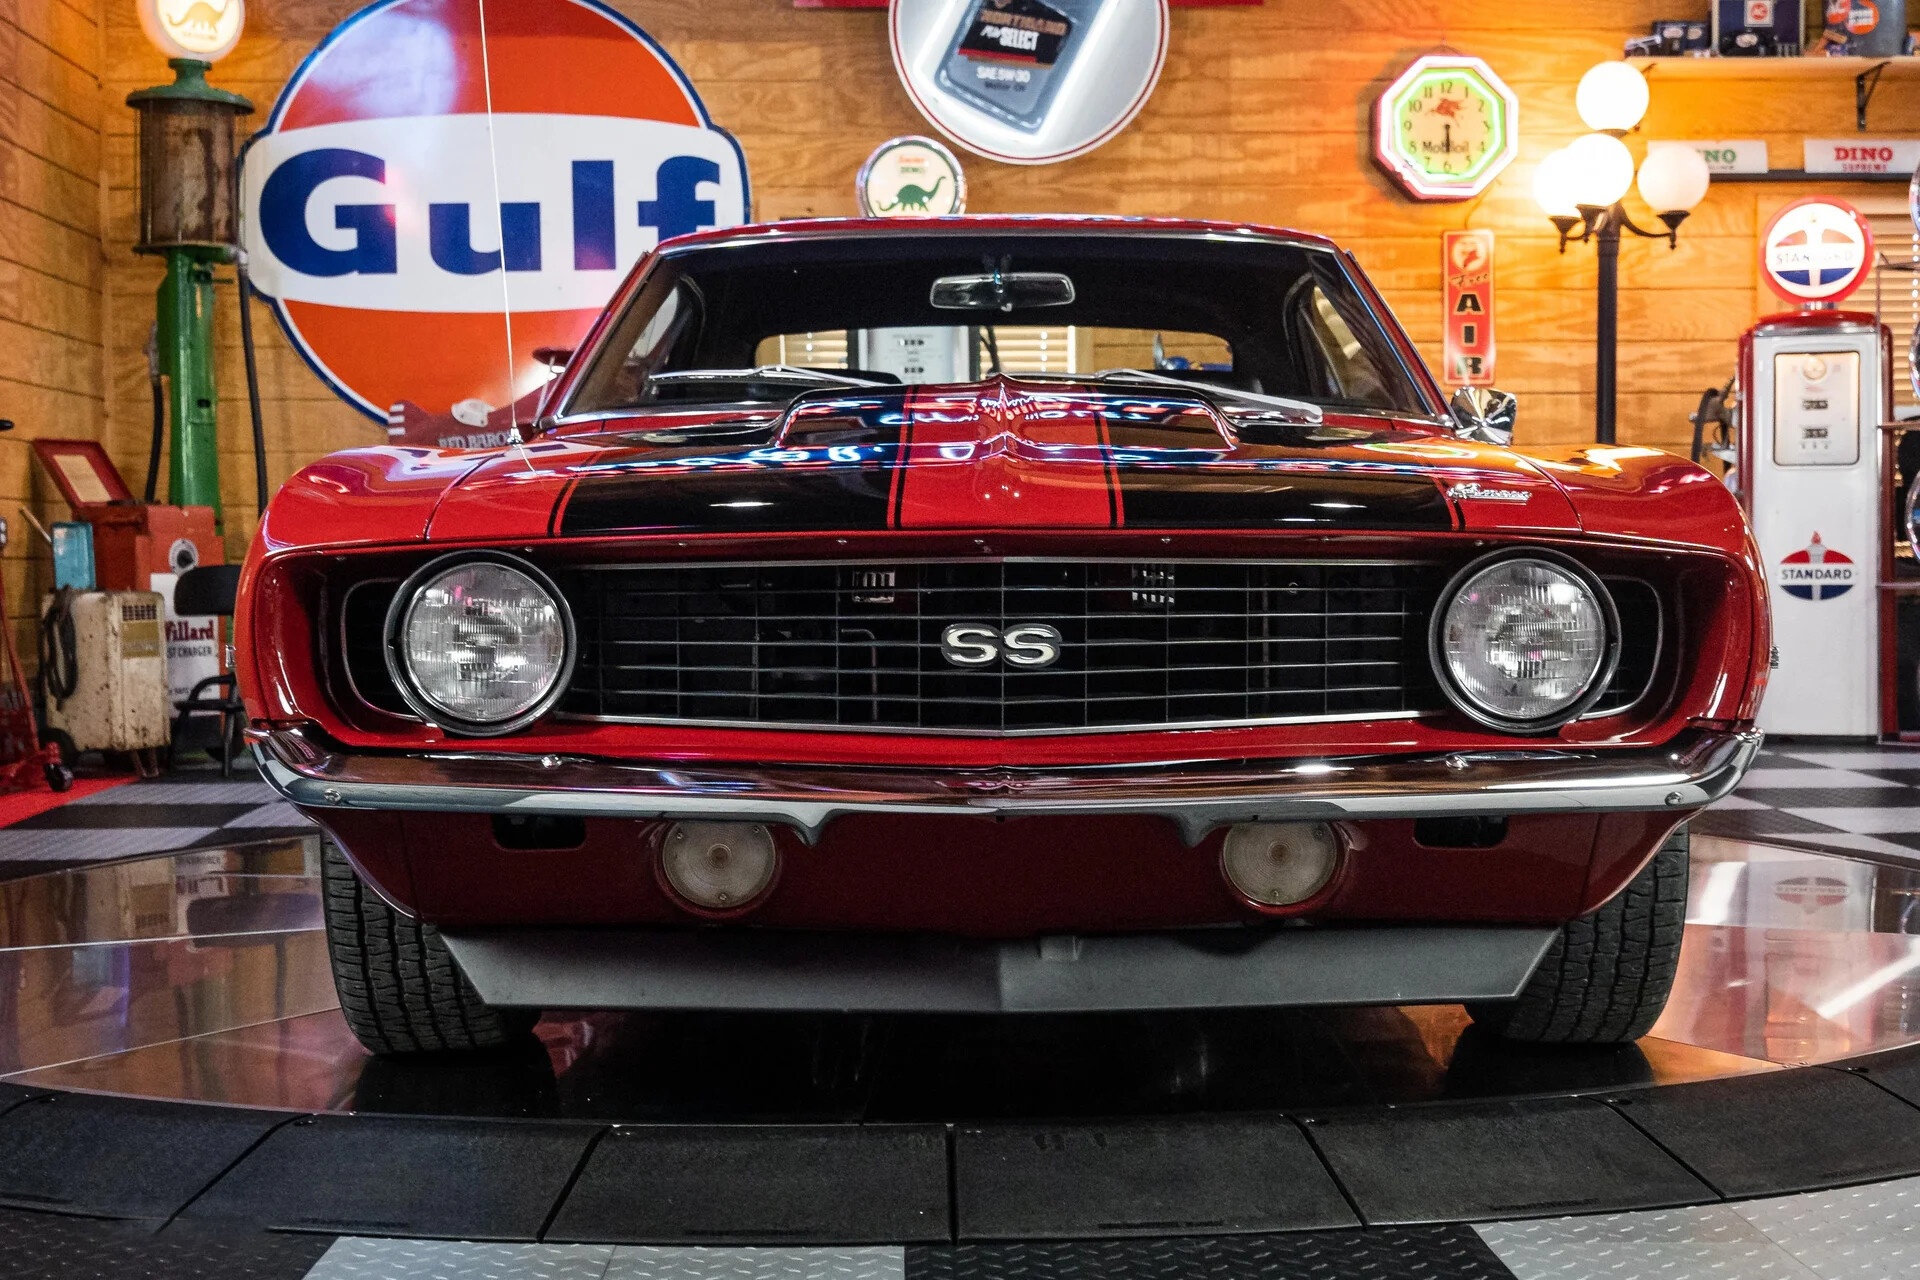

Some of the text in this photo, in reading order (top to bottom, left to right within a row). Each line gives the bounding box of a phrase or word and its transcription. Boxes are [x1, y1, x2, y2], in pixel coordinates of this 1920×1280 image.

[1000, 27, 1040, 50] SELECT
[1424, 81, 1469, 98] 11 12 1
[1409, 100, 1484, 112] 10 2
[1404, 120, 1412, 131] 9
[1834, 147, 1894, 161] DINO
[1424, 156, 1430, 165] 7
[1443, 161, 1452, 172] 6
[259, 148, 720, 277] Gulf
[1456, 293, 1483, 375] AIR
[1781, 569, 1852, 580] STANDARD
[943, 625, 1058, 666] SS
